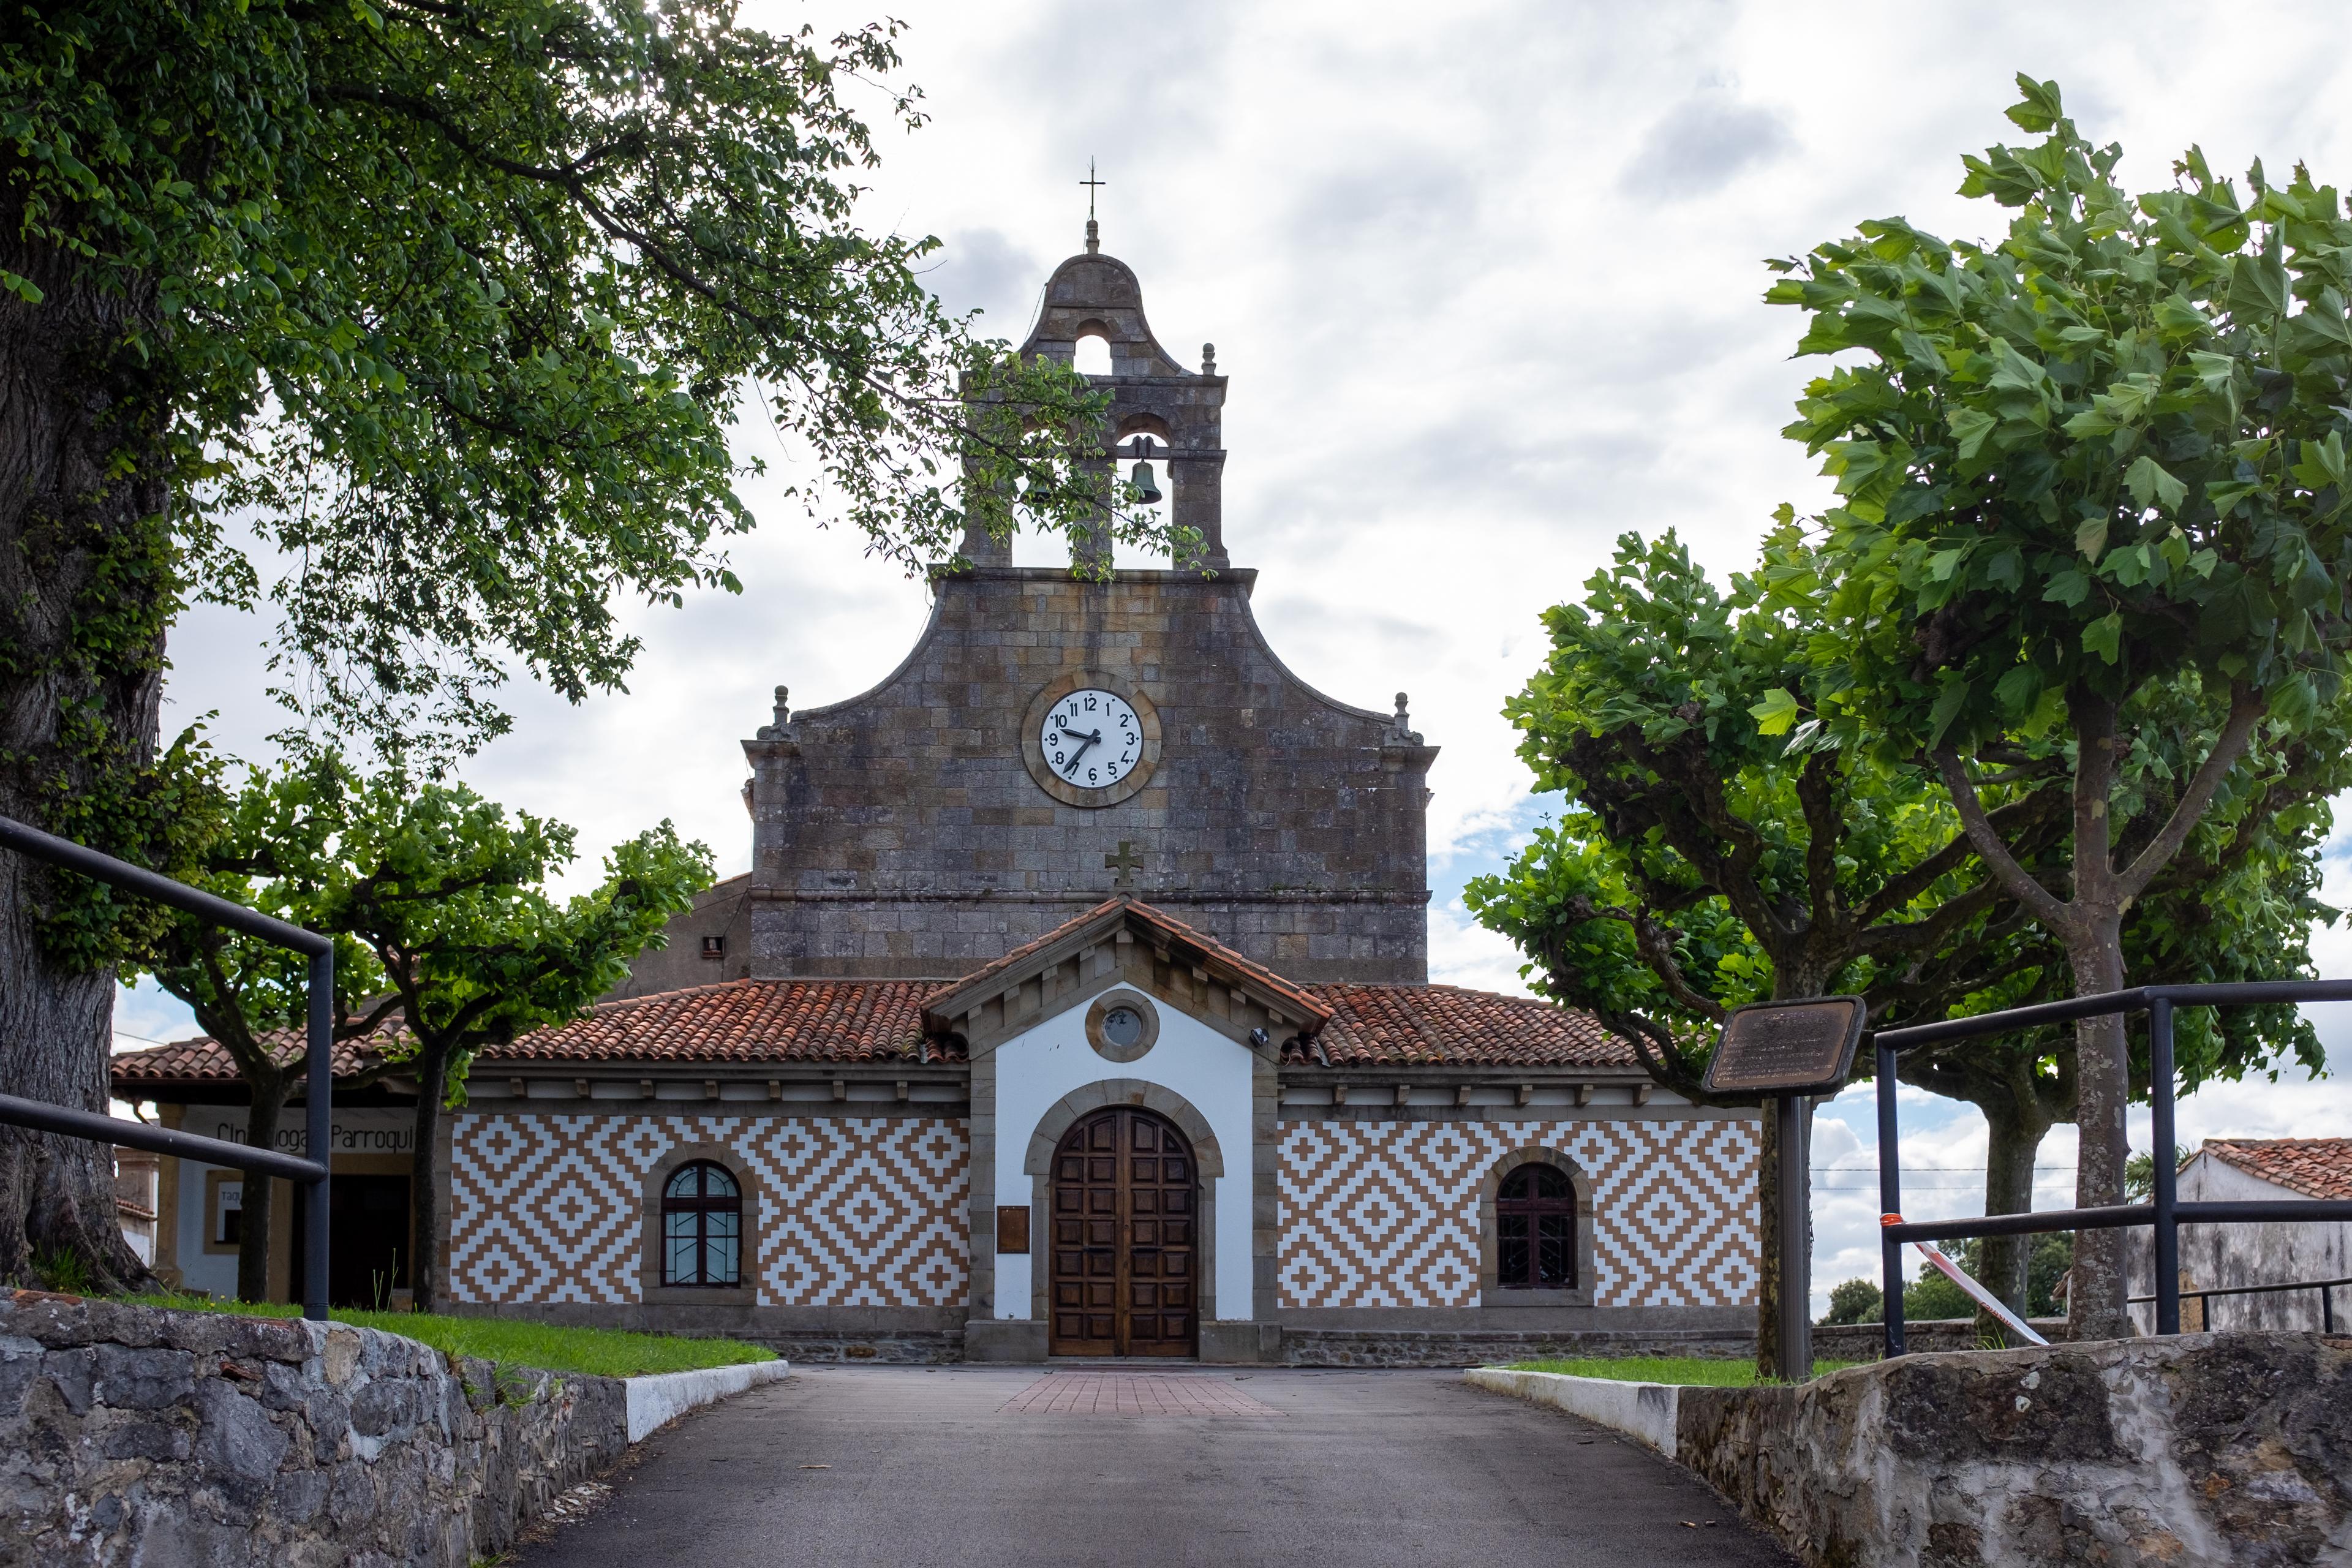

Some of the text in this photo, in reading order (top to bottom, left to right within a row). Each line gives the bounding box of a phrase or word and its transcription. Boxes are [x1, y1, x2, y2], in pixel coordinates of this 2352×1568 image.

[1069, 703, 1078, 717] 11
[1084, 697, 1097, 712] 12
[1106, 702, 1110, 716] 1
[1054, 714, 1068, 728] 10
[1120, 714, 1129, 727] 2
[1049, 733, 1058, 746] 9
[1126, 732, 1135, 745] 3
[1055, 752, 1065, 764] 8
[1120, 750, 1129, 764] 4
[1071, 762, 1080, 775] 7
[1088, 767, 1097, 781] 6
[1108, 762, 1117, 775] 5
[217, 1123, 246, 1144] Cin
